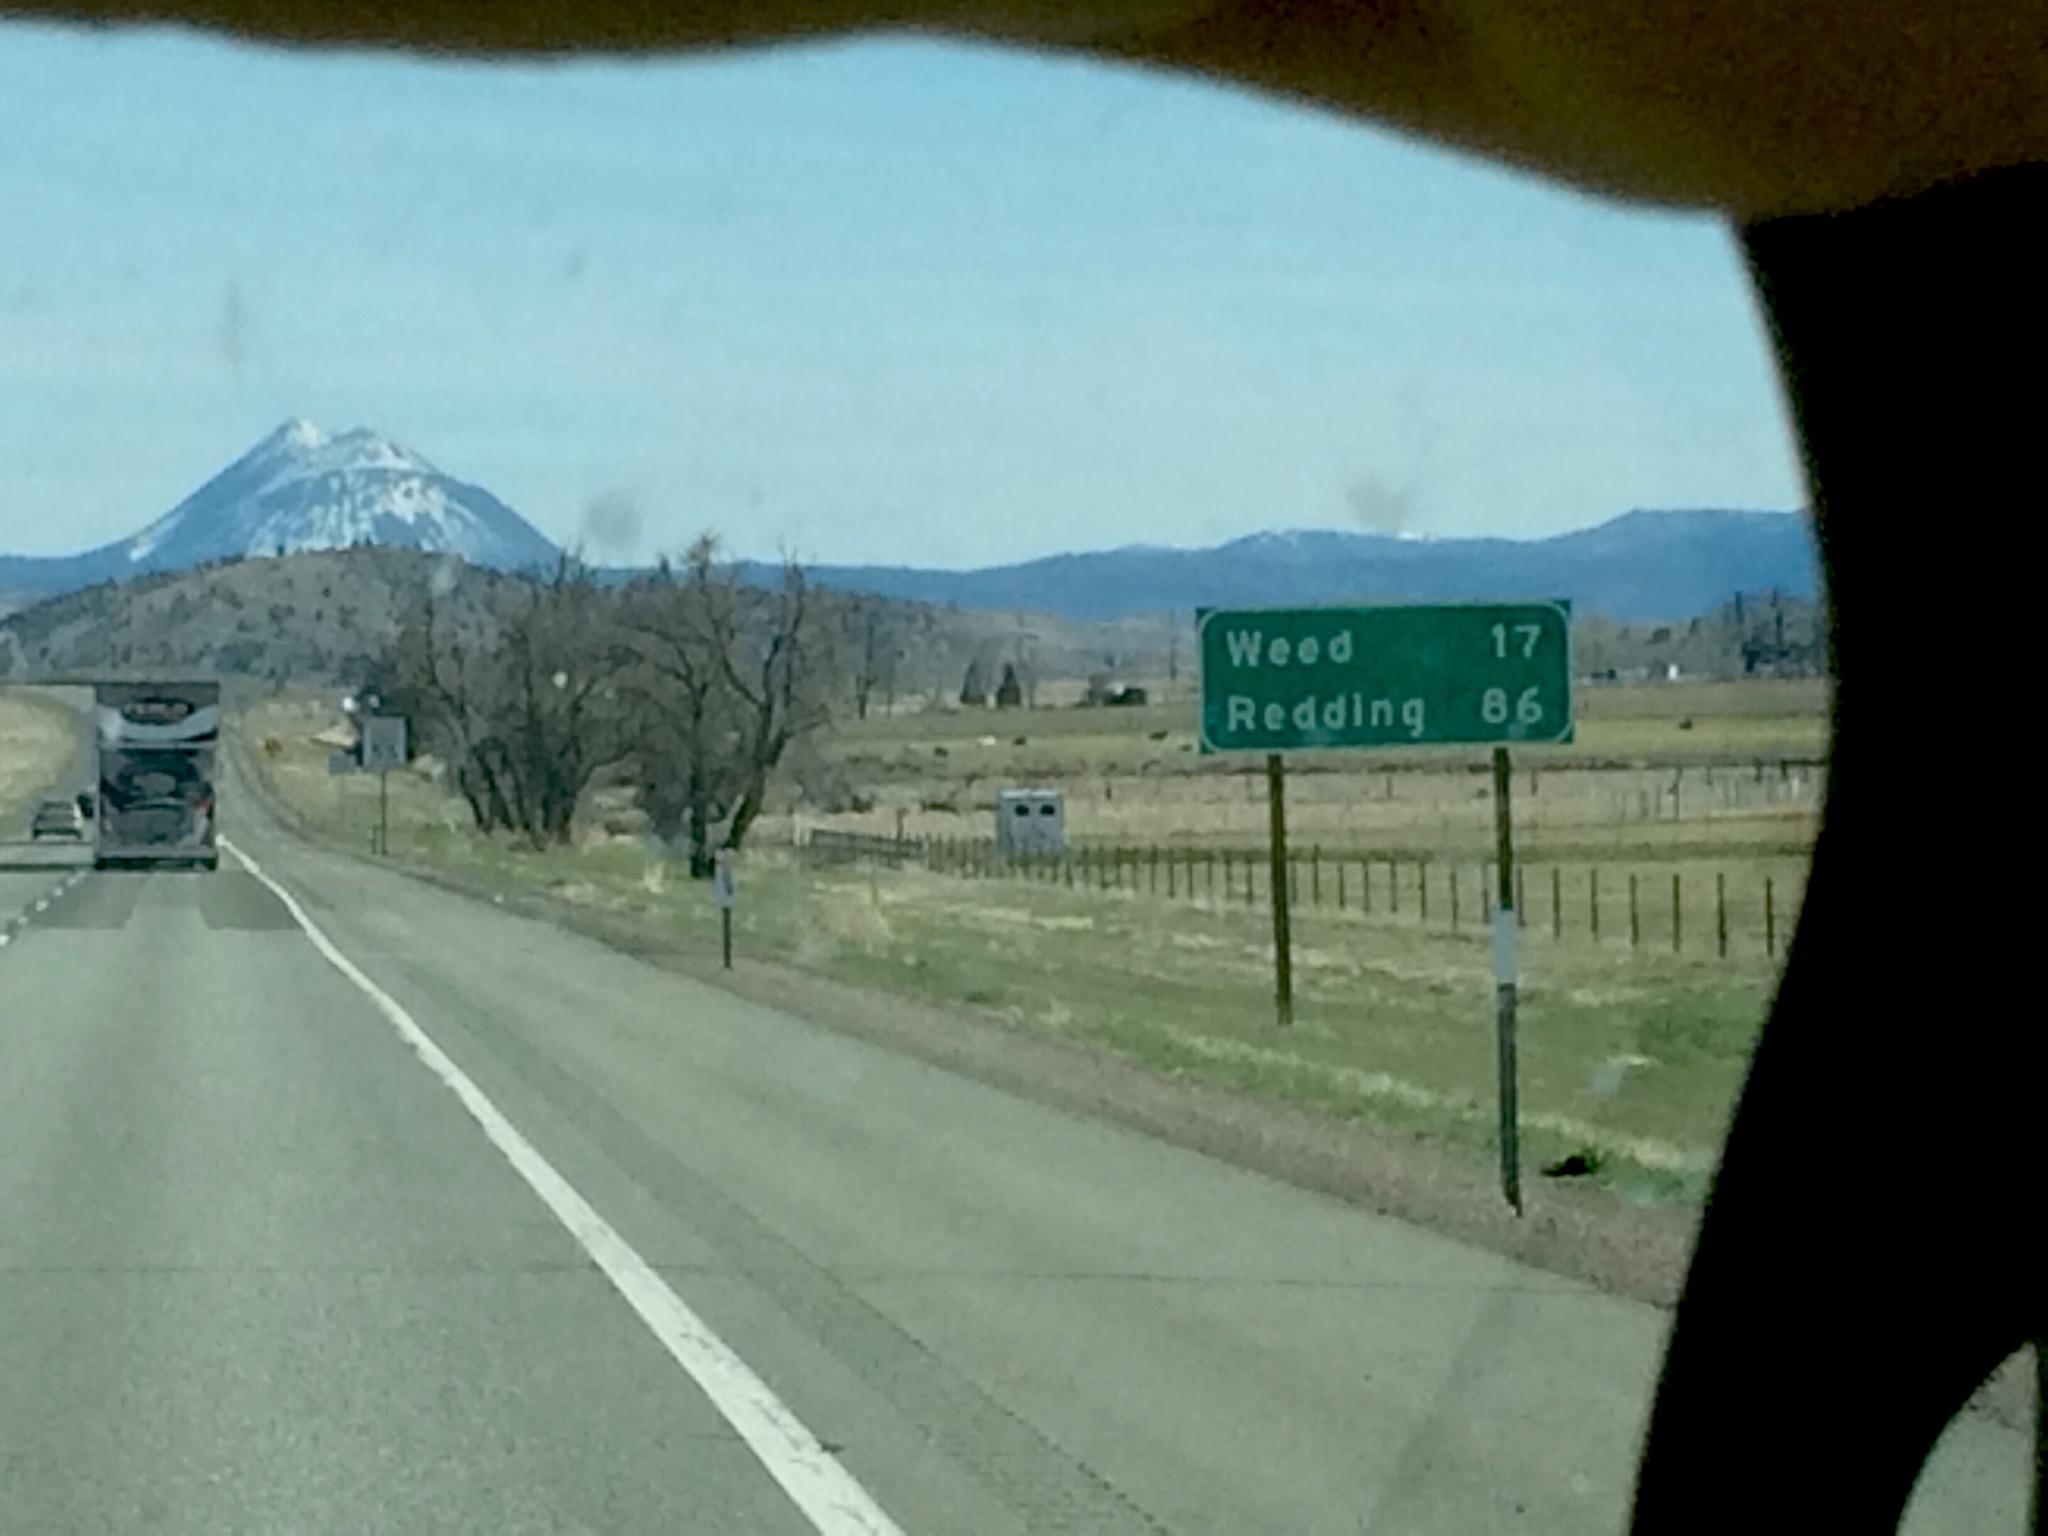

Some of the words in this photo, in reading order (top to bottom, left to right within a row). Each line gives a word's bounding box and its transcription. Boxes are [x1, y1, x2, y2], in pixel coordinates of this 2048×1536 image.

[1226, 629, 1353, 667] Weed
[1491, 622, 1542, 659] 17
[1227, 692, 1425, 738] Redding
[1481, 686, 1544, 724] 86
